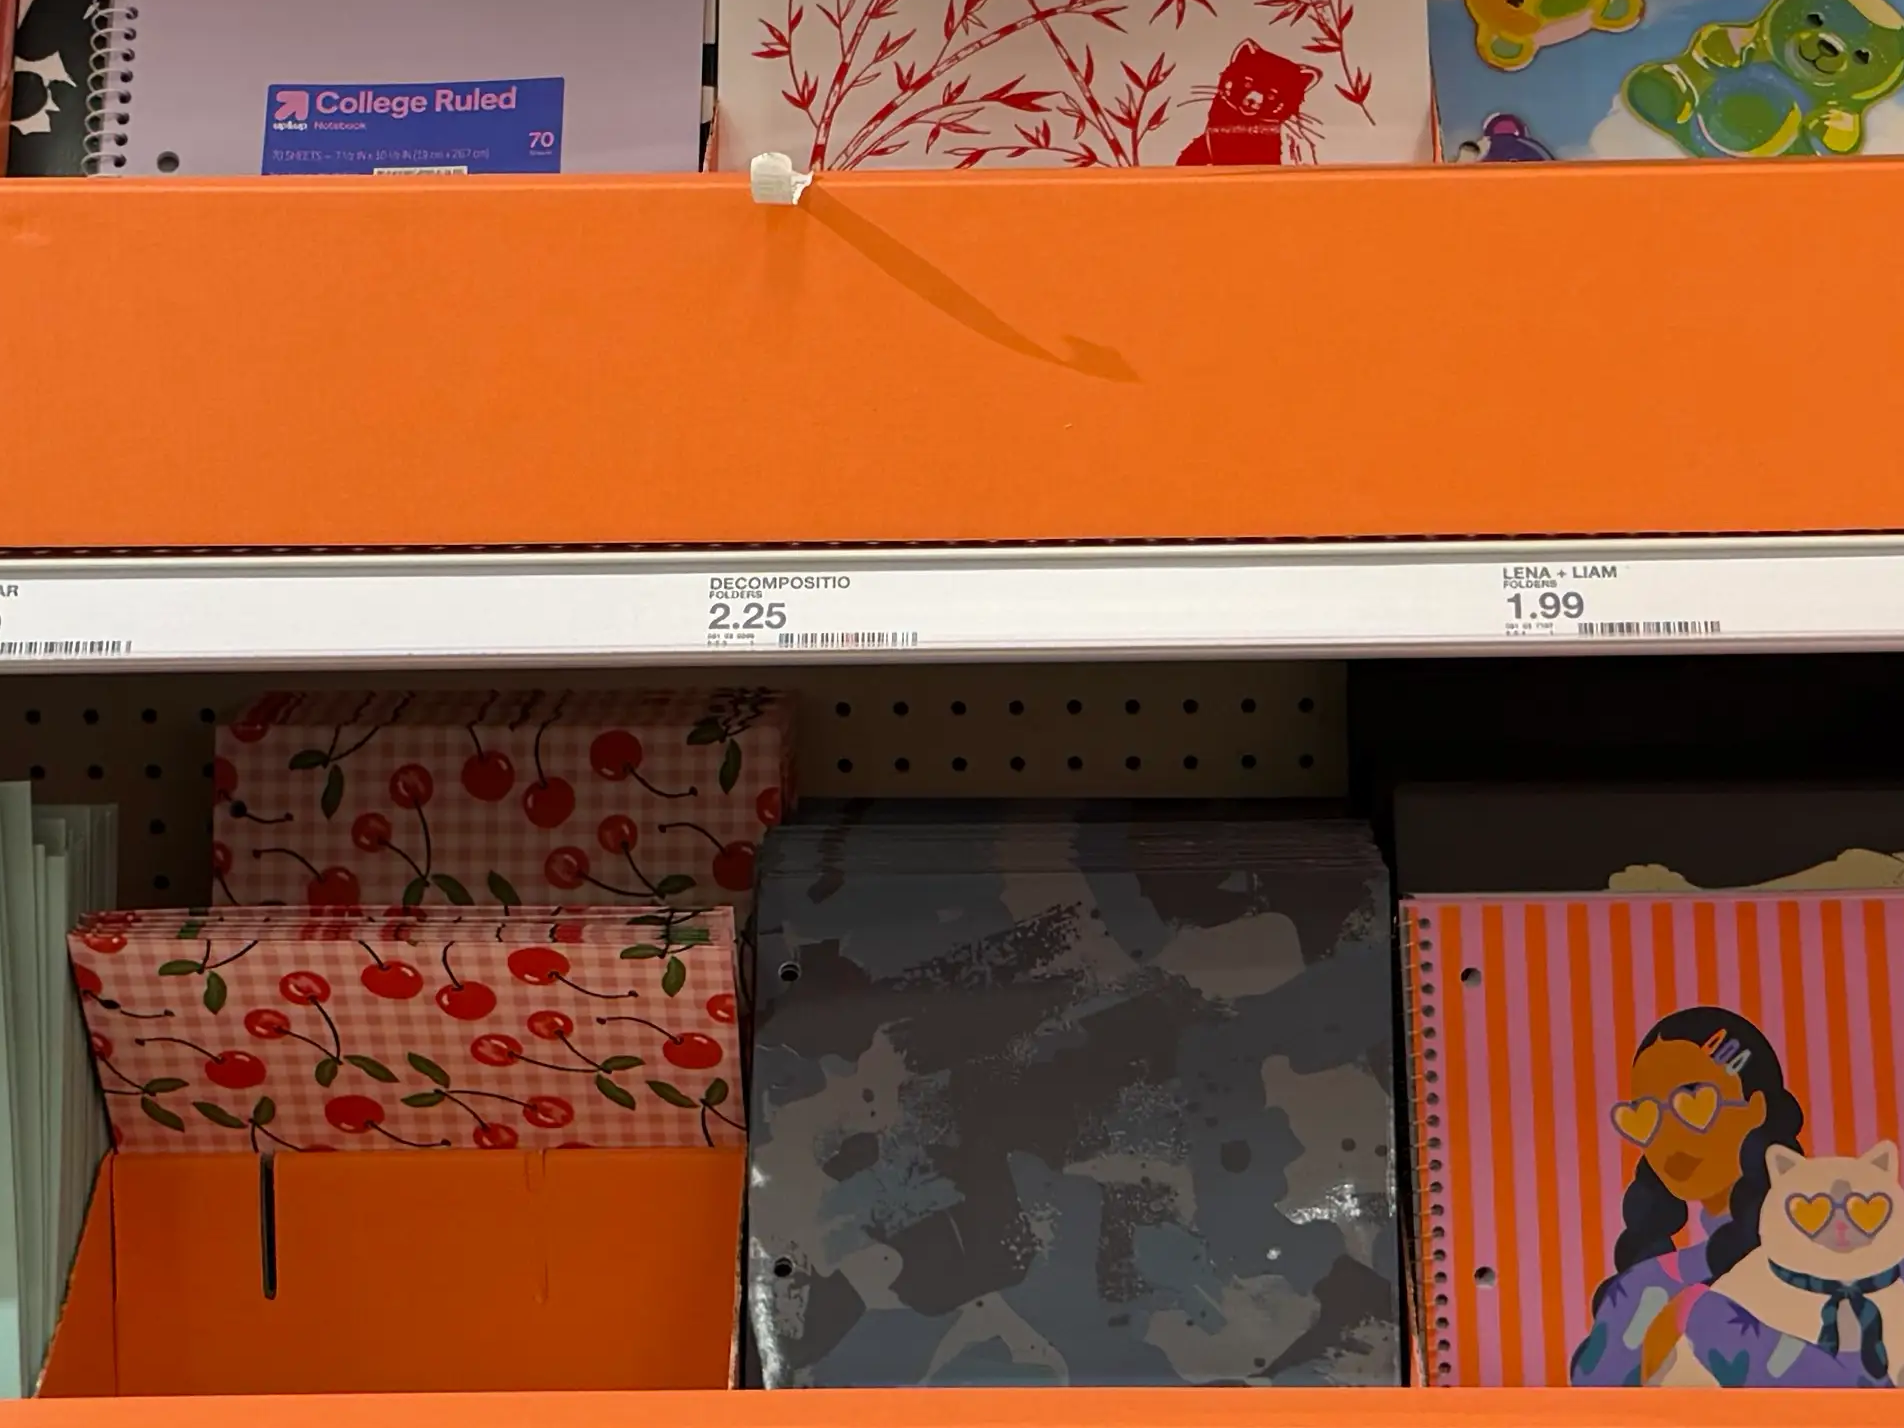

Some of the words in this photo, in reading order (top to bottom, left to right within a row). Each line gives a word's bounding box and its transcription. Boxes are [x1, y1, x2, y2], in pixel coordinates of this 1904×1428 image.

[316, 90, 428, 118] College
[435, 86, 517, 112] Ruled
[314, 121, 366, 130] Notebook
[528, 132, 555, 149] 70
[1503, 566, 1551, 580] LENA
[1573, 566, 1617, 578] LIAM
[710, 576, 851, 590] DECOMPOSITIO
[1503, 580, 1557, 589] FOLDERS
[709, 590, 763, 599] FOLDERS
[1507, 592, 1584, 619] 1.99
[709, 602, 786, 629] 2.25
